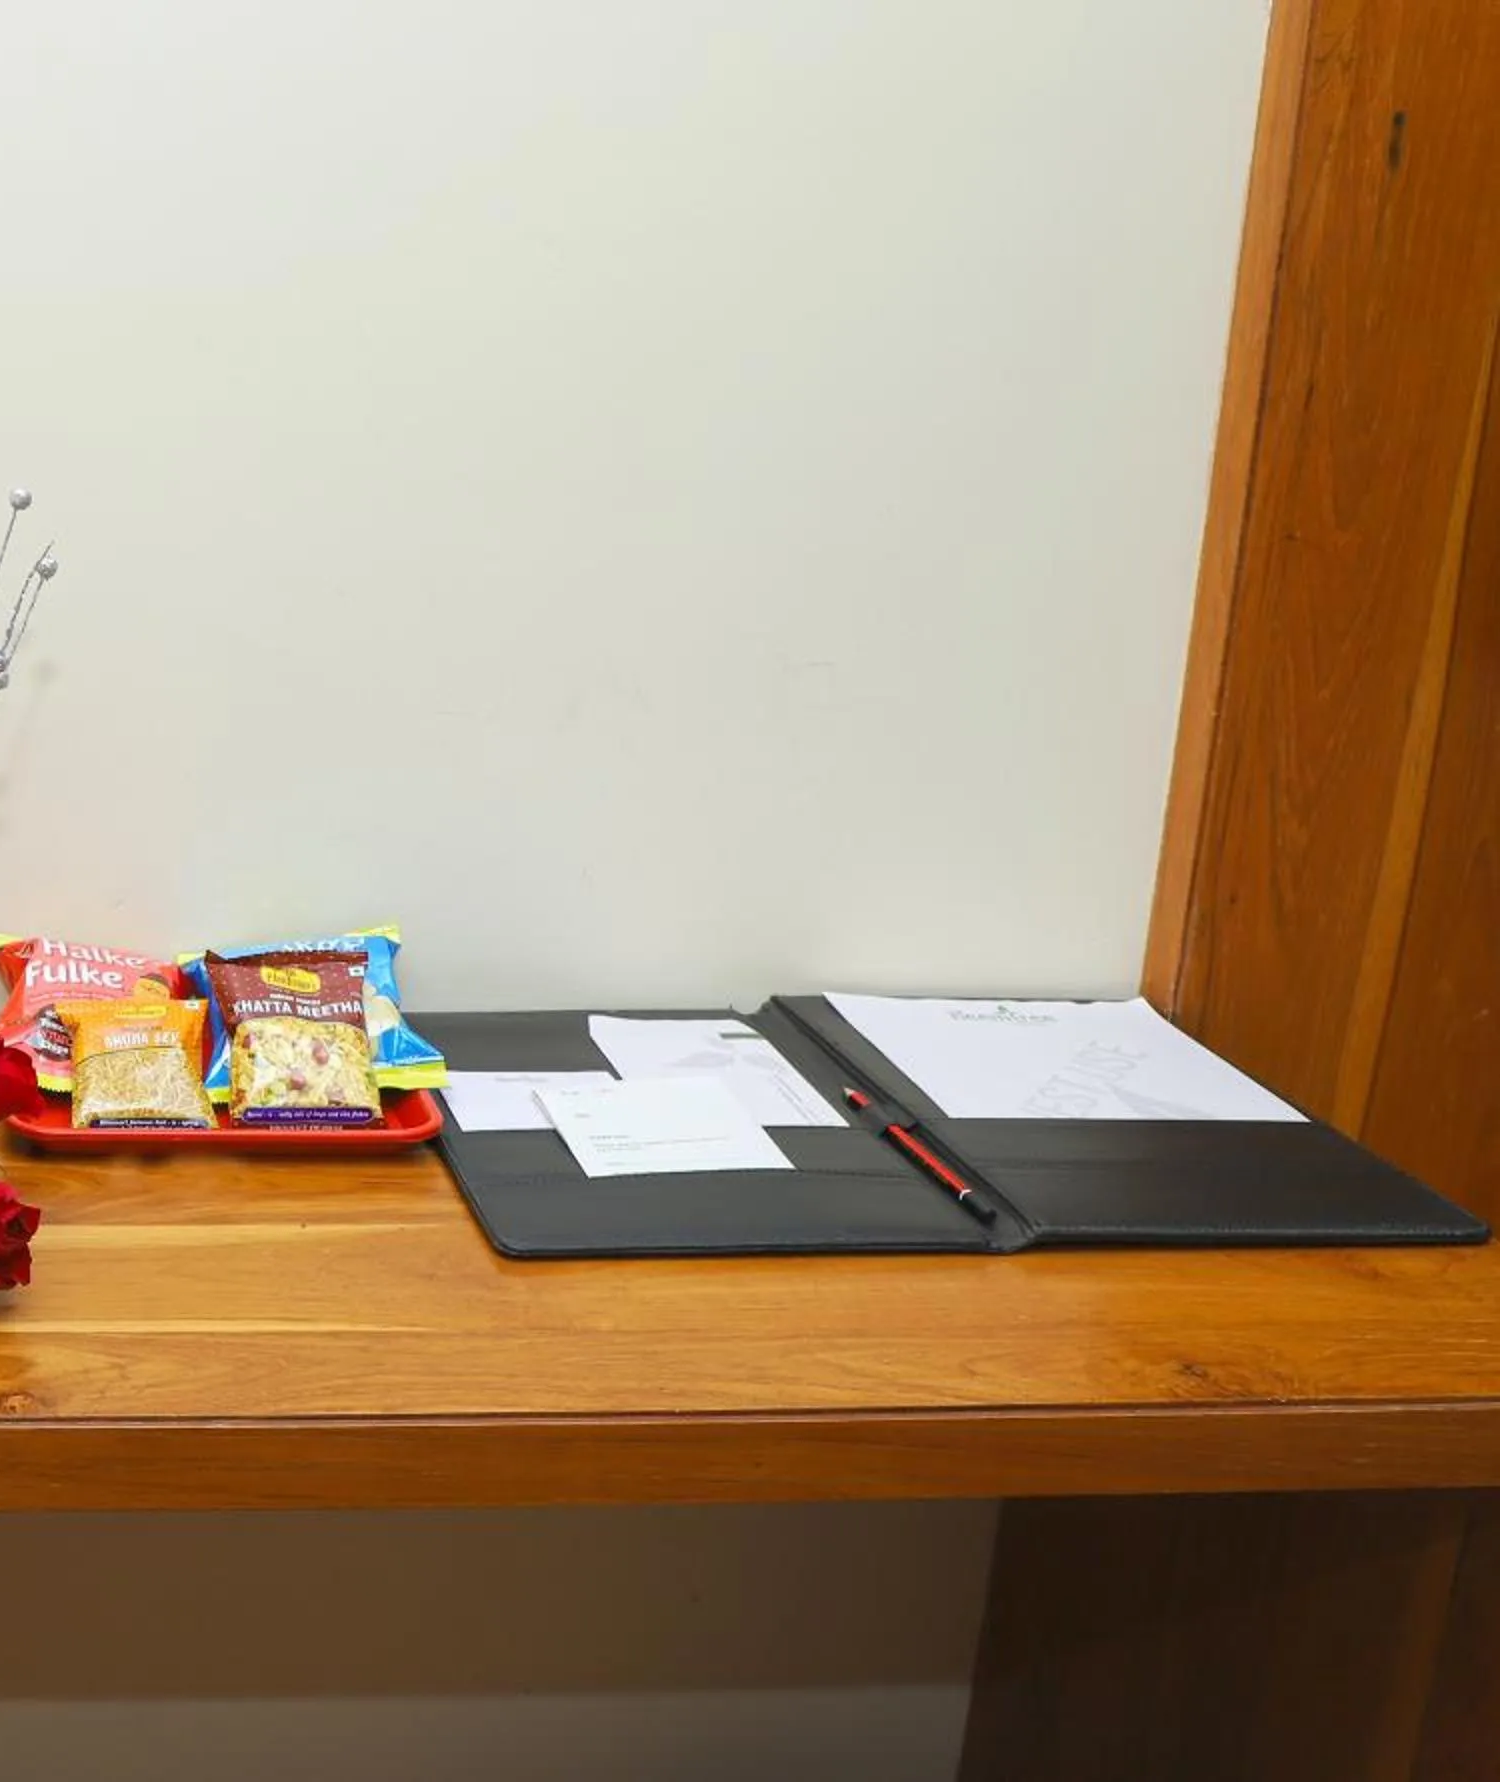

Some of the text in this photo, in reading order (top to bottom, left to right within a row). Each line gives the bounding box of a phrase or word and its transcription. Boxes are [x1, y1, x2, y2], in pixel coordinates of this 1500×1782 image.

[42, 936, 147, 969] Halke
[25, 959, 124, 989] Fulke
[295, 1000, 364, 1018] MEETHA
